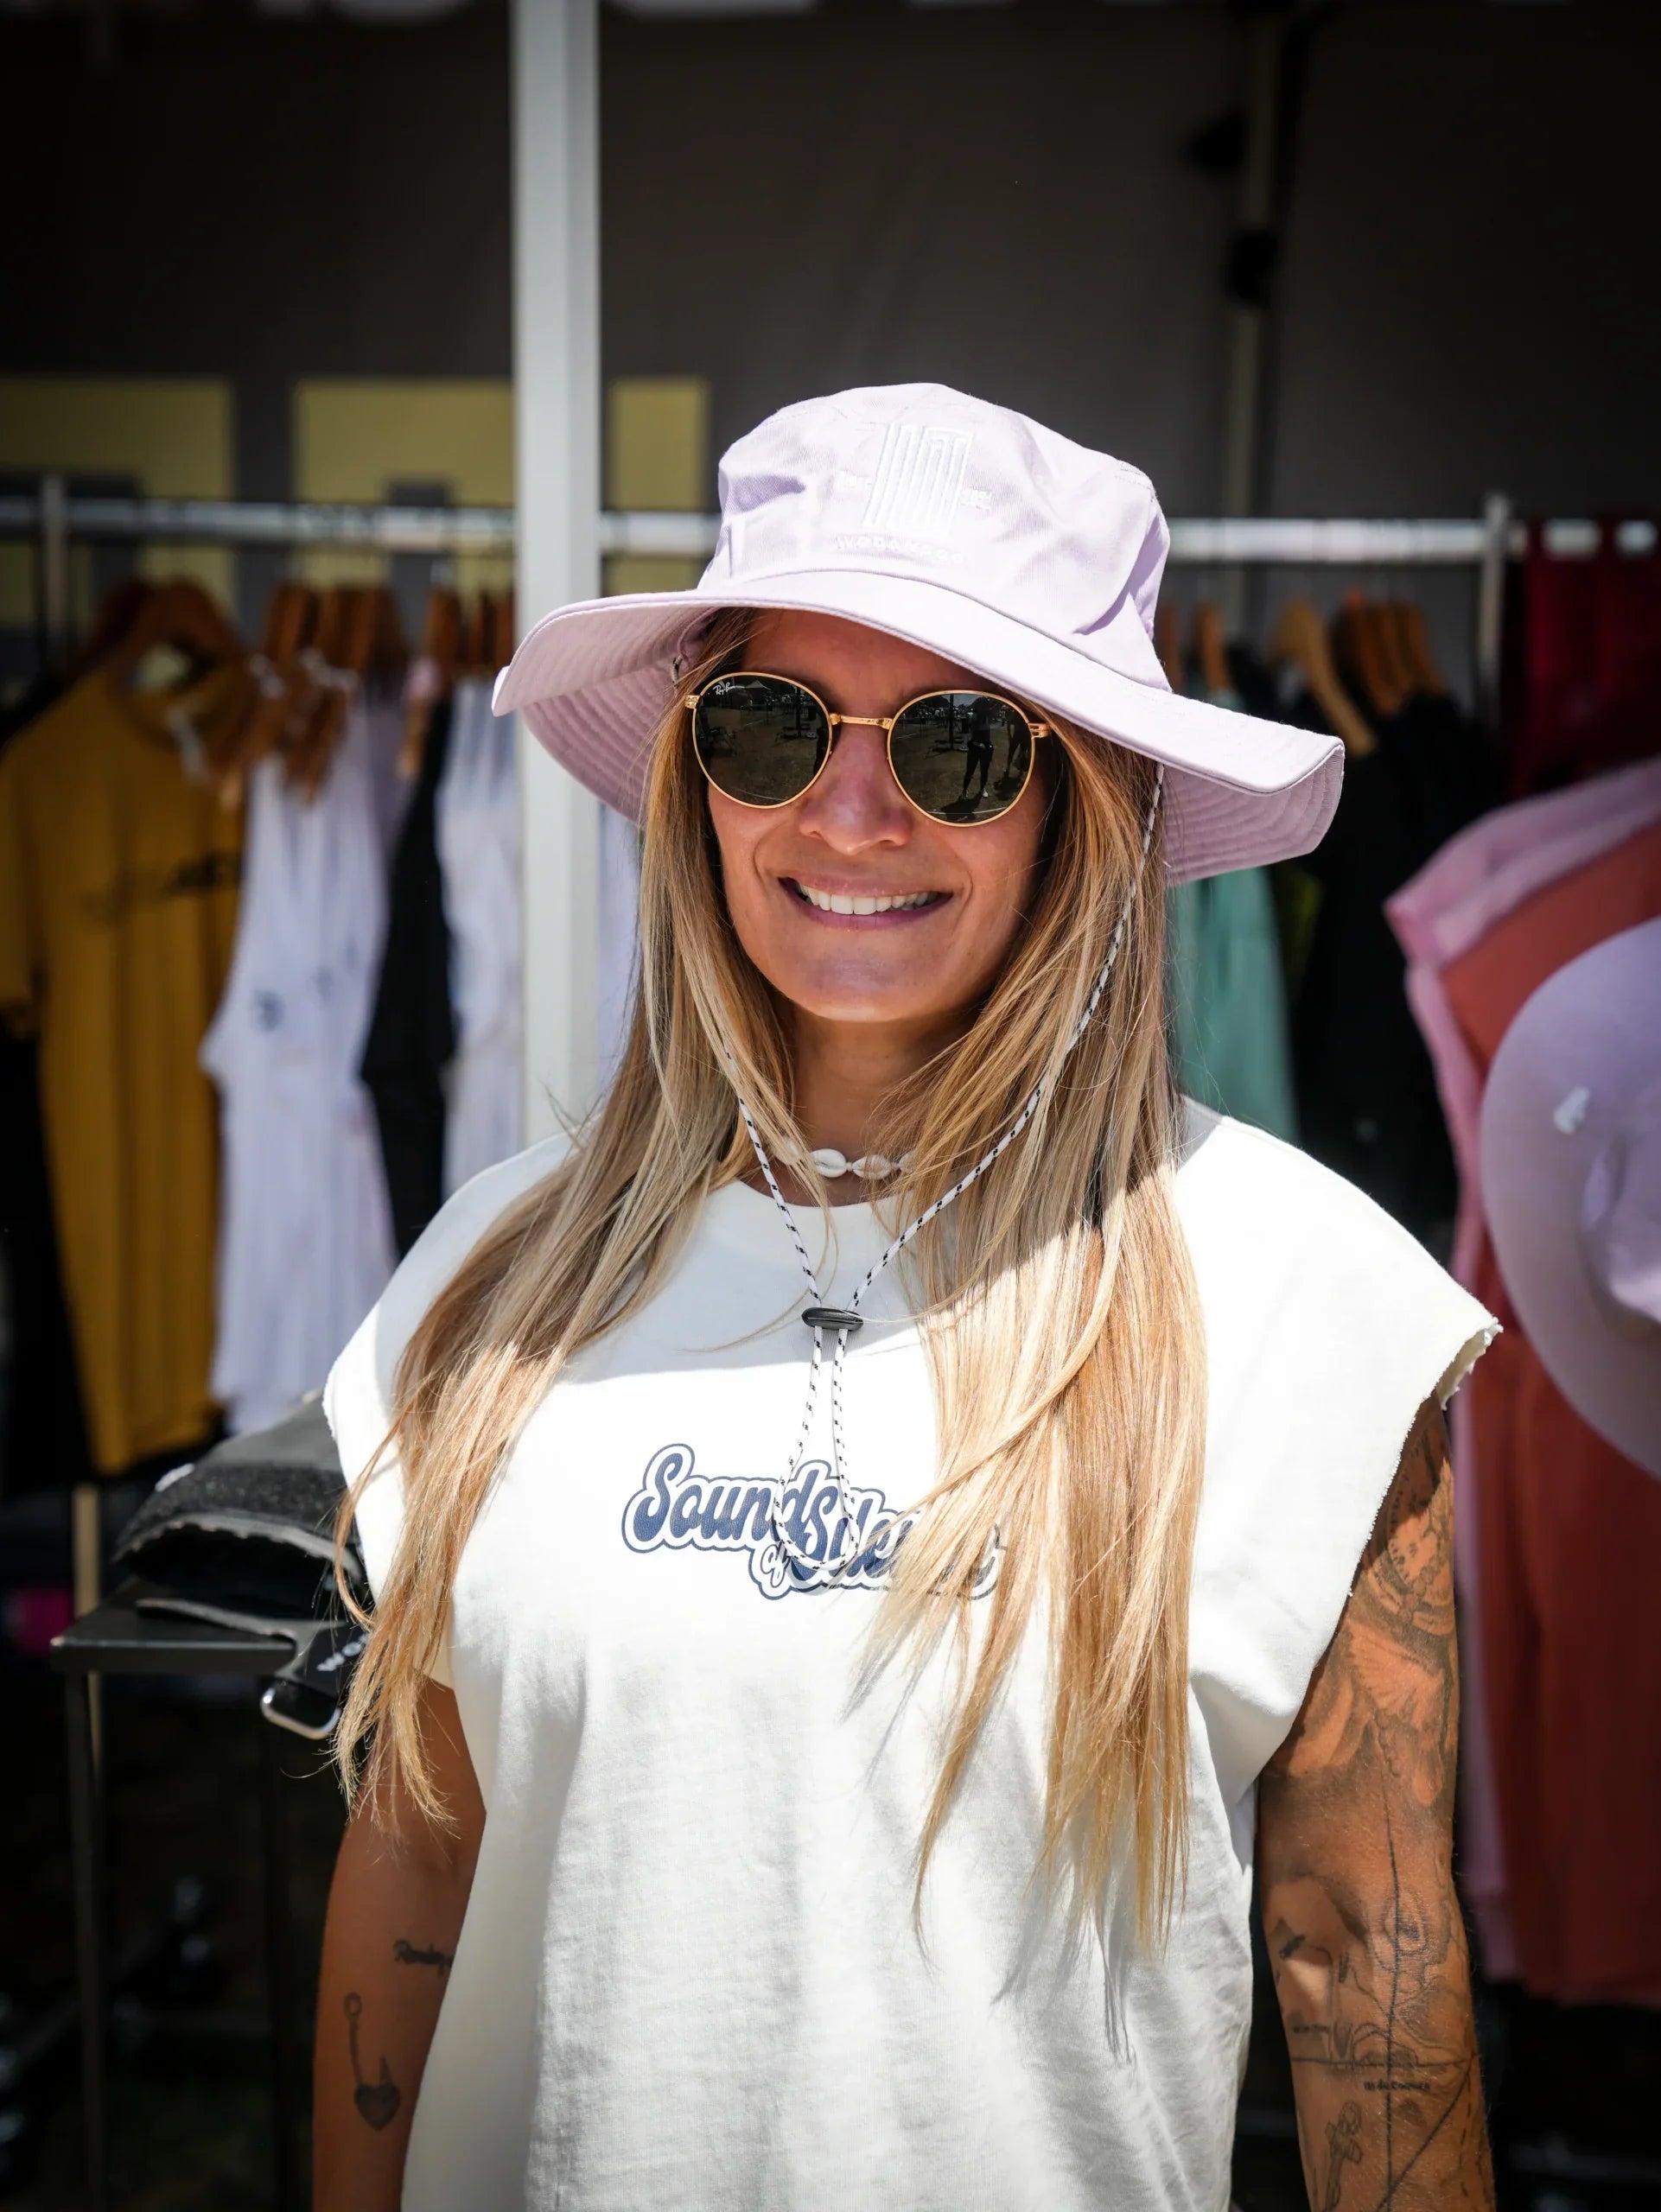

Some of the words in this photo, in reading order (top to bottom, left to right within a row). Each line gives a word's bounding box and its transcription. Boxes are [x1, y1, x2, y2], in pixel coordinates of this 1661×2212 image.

[713, 682, 735, 696] Ray-Ban
[631, 1451, 819, 1542] Sound
[760, 1543, 792, 1588] of
